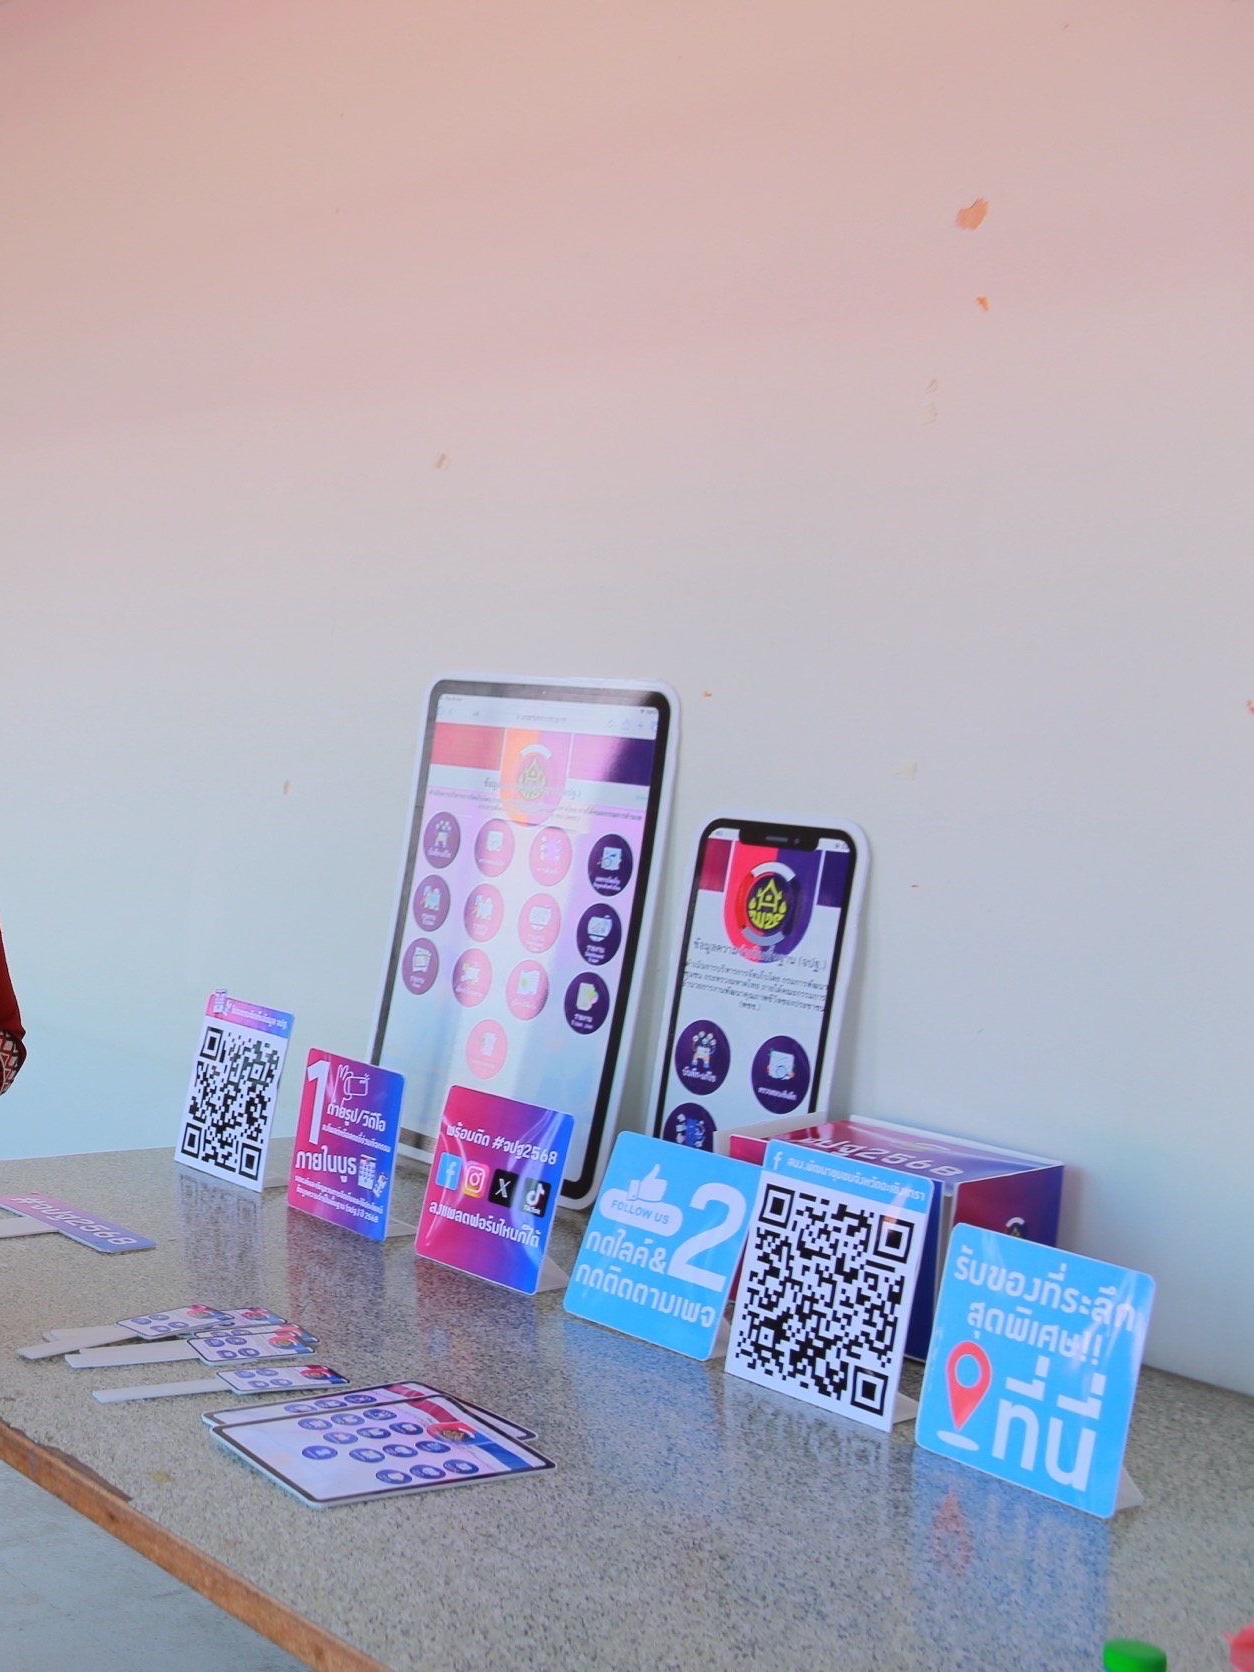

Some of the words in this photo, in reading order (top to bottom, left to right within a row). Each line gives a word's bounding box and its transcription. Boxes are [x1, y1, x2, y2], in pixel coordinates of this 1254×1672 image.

[307, 1060, 330, 1145] 1
[446, 1121, 490, 1146] พร้อมติด
[491, 1135, 558, 1165] #จปฐ2568
[429, 1201, 542, 1248] ลงแพลตฟอร์มไหนก็ได้
[610, 1199, 653, 1219] FOLLOW
[654, 1212, 670, 1225] US
[667, 1182, 746, 1293] 2
[585, 1228, 668, 1275] กดไลค์&
[575, 1263, 716, 1328] กดติดตามเพจ
[954, 1244, 1136, 1332] รับของที่ระลึก
[967, 1302, 1104, 1366] สุดพิเศษ!!
[992, 1355, 1107, 1492] ที่นี่
